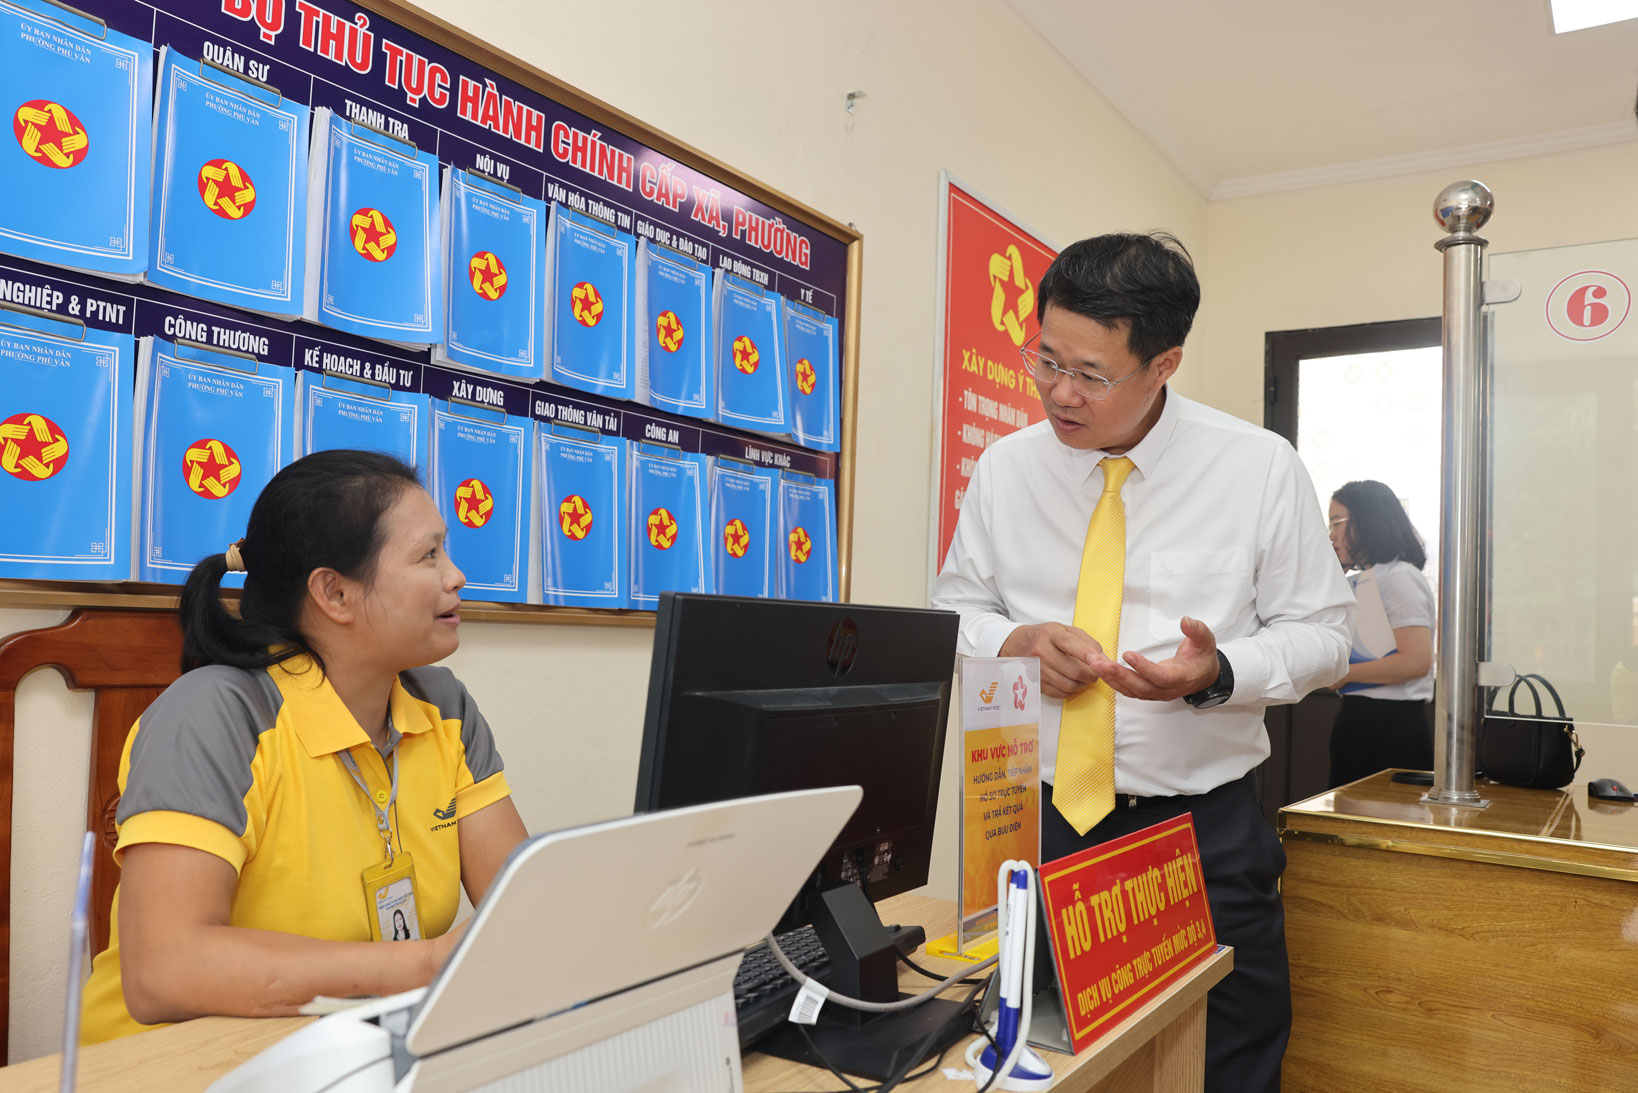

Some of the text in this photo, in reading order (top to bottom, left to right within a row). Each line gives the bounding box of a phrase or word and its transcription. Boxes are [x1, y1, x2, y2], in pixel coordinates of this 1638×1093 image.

[34, 28, 50, 39] BAN
[52, 35, 74, 48] NHÂN
[76, 44, 92, 56] DÂN
[203, 41, 245, 74] QUÂN
[216, 96, 228, 106] BAN
[230, 102, 246, 112] NHÂN
[248, 109, 260, 118] DÂN
[344, 98, 409, 140] THANH TRA
[296, 0, 374, 75] THỦ
[382, 38, 450, 108] TỤC
[457, 75, 545, 152] HÀNH
[552, 120, 634, 192] CHÍNH
[638, 163, 688, 212] CẤP
[691, 185, 729, 236] XÃ,
[732, 205, 811, 270] PHƯỜNG
[362, 151, 372, 159] BAN
[475, 153, 510, 183] NỘI VỤ
[547, 182, 631, 229] VĂN HÓA THÔNG TIN
[636, 220, 654, 238] GIÁO
[672, 235, 678, 248] &
[678, 237, 693, 254] ĐÀO
[694, 244, 707, 261] TẠO
[719, 254, 732, 270] LAO
[752, 268, 769, 286] TBXH
[0, 278, 126, 325] NGHIỆP & PTNT
[800, 288, 814, 304] Y TẾ
[1566, 284, 1609, 328] 6
[14, 342, 31, 351] BAN
[32, 344, 54, 356] NHÂN
[56, 349, 72, 358] DÂN
[164, 314, 269, 356] CÔNG THƯƠNG
[54, 358, 71, 367] VÂN
[304, 346, 322, 368] KẾ
[363, 362, 372, 380] &
[374, 360, 397, 384] ĐẦU
[399, 370, 413, 388] TƯ
[962, 347, 985, 376] XÂY
[987, 360, 1016, 390] DỰNG
[1018, 368, 1025, 392] Ý
[212, 378, 230, 387] NHÂN
[231, 382, 244, 390] DÂN
[452, 380, 504, 406] XÂY DỰNG
[535, 400, 556, 418] GIAO
[557, 404, 585, 424] THÔNG
[604, 412, 618, 432] TẢI
[645, 422, 680, 444] CÔNG AN
[761, 450, 774, 466] VỰC
[774, 452, 791, 468] KHÁC
[972, 738, 1034, 763] KHU VỰC HỖ TRỢ
[430, 820, 456, 832] VIETNAM
[984, 808, 991, 821] VÀ
[1002, 803, 1012, 816] KẾT
[985, 828, 997, 841] QUA
[1061, 882, 1092, 960] HỖ
[1089, 879, 1127, 944] TRỢ
[1124, 865, 1165, 926] THỰC
[1164, 848, 1198, 908] HIỆN
[1077, 984, 1100, 1018] DỊCH
[1098, 976, 1112, 1004] VỤ
[1112, 964, 1135, 994] CÔNG
[1132, 950, 1153, 980] TRỰC
[1151, 933, 1174, 968] TUYẾN
[1172, 924, 1188, 955] MỨC
[1187, 920, 1198, 946] ĐỘ
